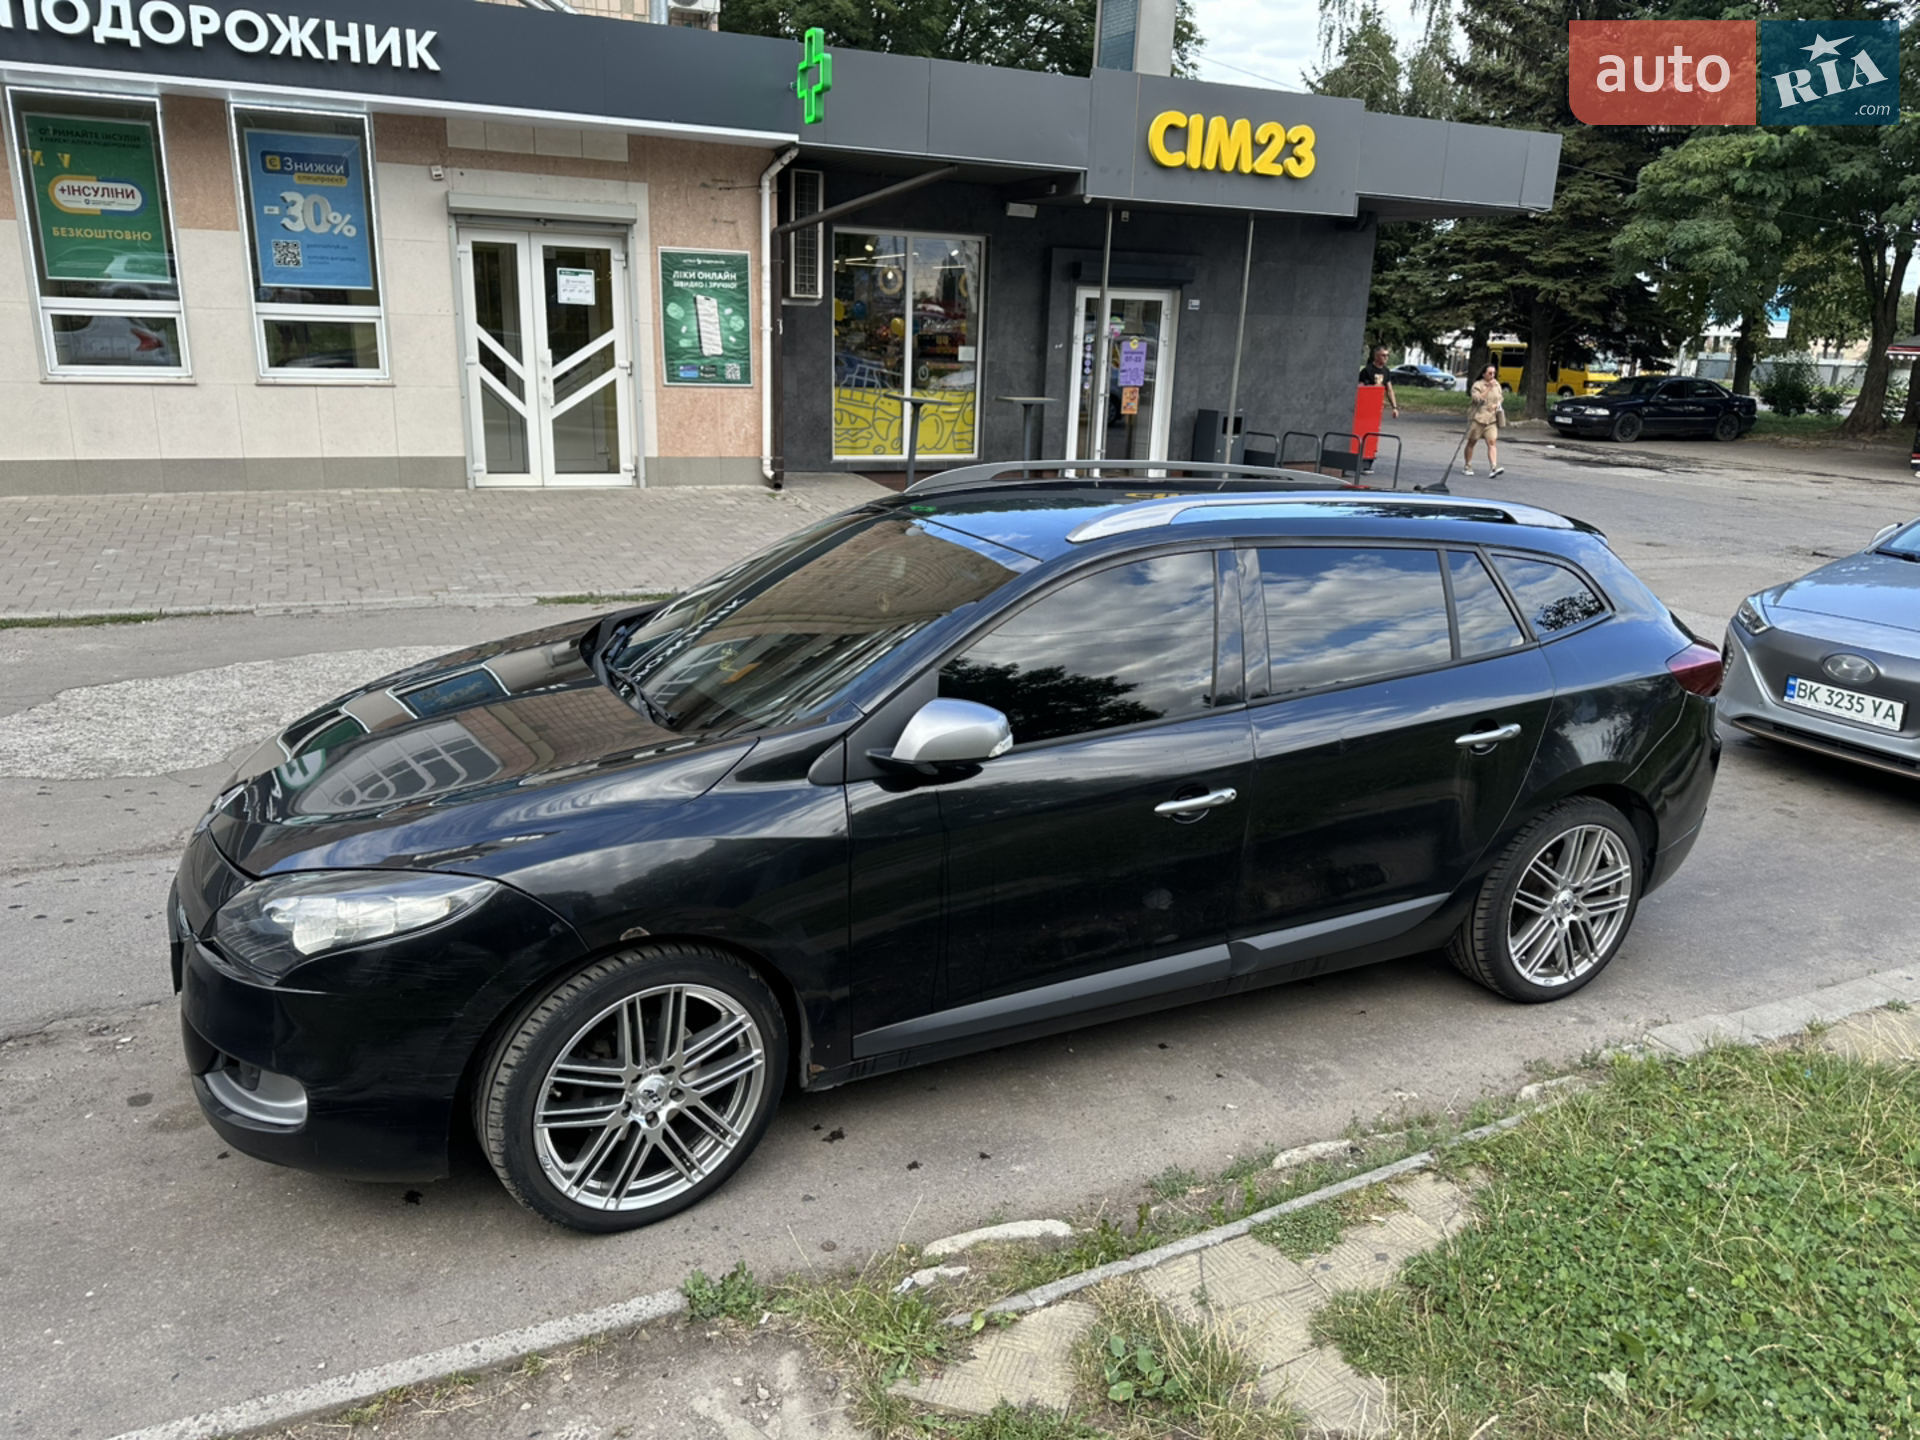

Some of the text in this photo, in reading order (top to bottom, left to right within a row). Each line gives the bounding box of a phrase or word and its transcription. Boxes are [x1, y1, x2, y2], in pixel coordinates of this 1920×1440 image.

[0, 0, 440, 71] ПОДОРОЖНИК
[101, 131, 141, 143] ІНСУЛІН
[283, 156, 345, 174] Знижки
[52, 226, 152, 241] БЕЗКОШТОВНО
[672, 270, 737, 281] ЛІКИ ОНЛАЙН
[673, 280, 704, 288] ШВИДКО
[1796, 682, 1896, 722] BK 3235 YA
